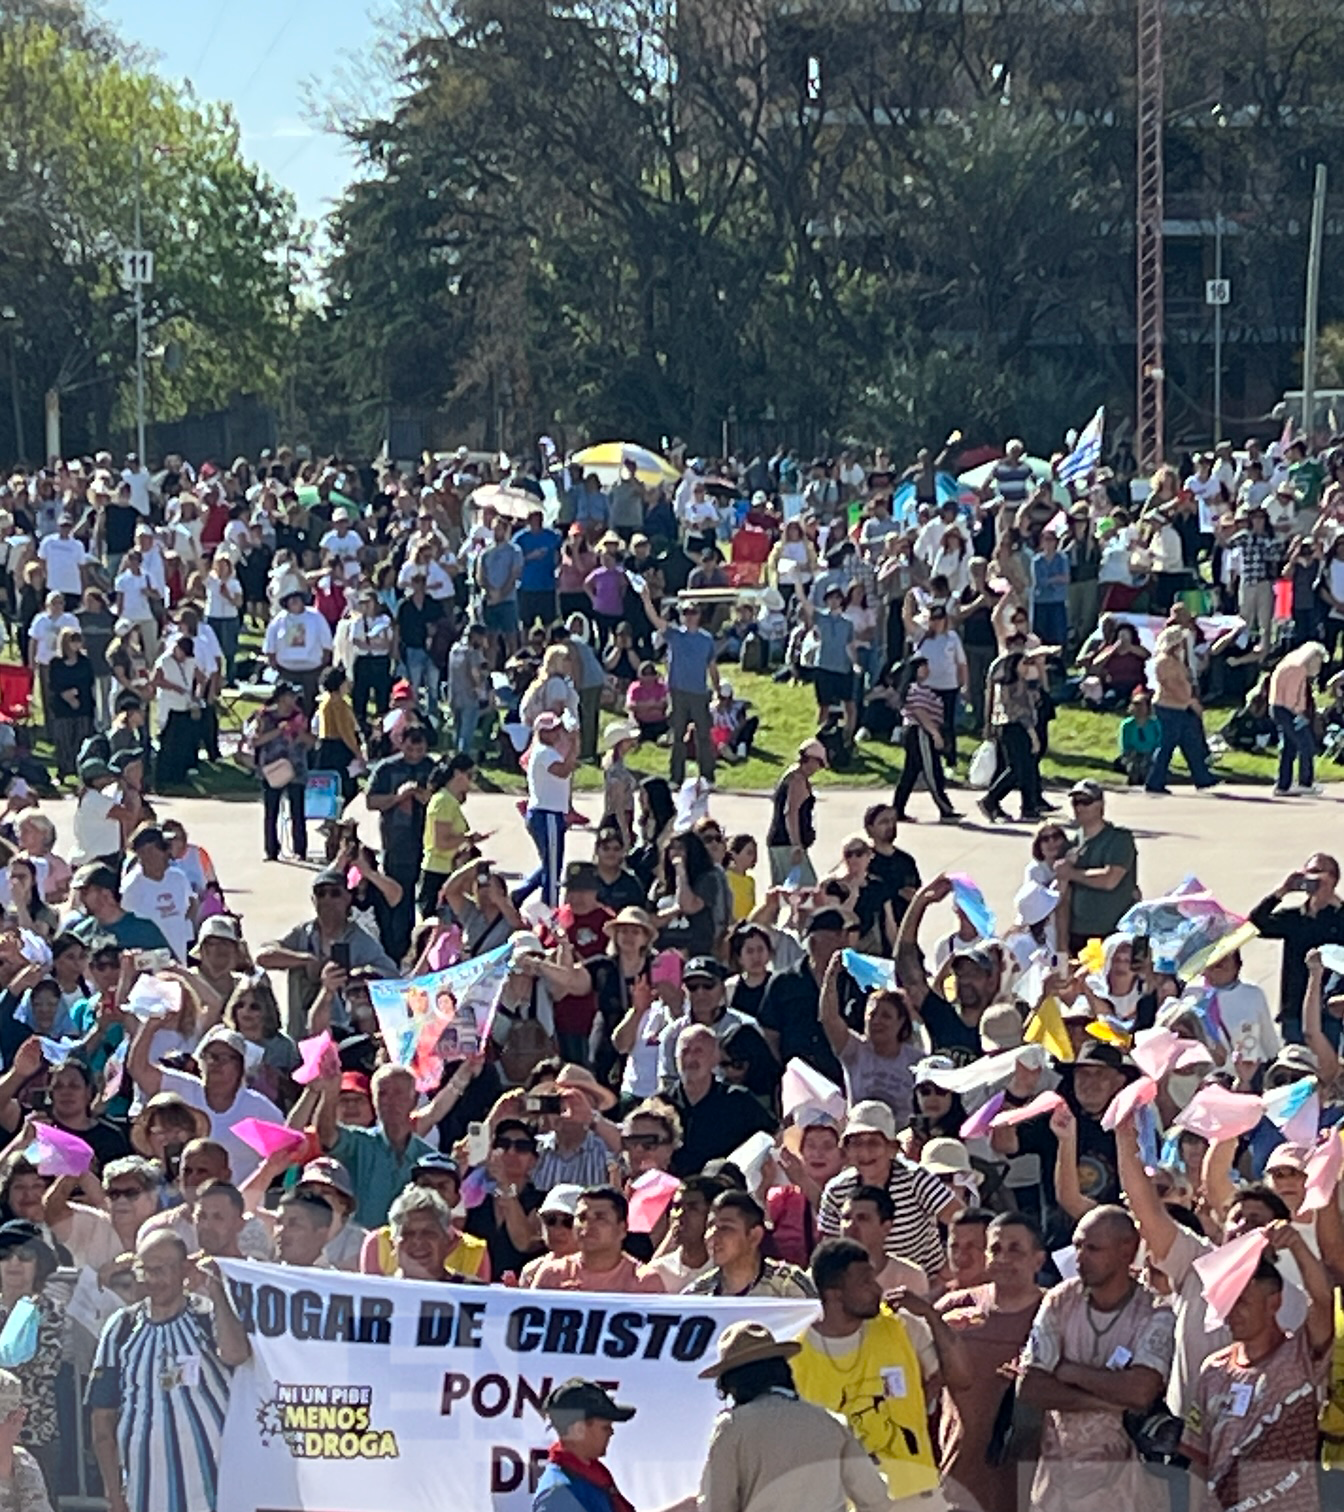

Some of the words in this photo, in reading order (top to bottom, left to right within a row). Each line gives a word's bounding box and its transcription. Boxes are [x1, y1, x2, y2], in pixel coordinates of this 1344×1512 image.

[229, 1278, 394, 1343] HOGAR
[416, 1302, 487, 1348] DE
[505, 1306, 716, 1362] CRISTO
[278, 1386, 298, 1403] NI
[301, 1386, 328, 1404] UN
[284, 1405, 369, 1430] MENOS
[304, 1432, 398, 1457] DROGA
